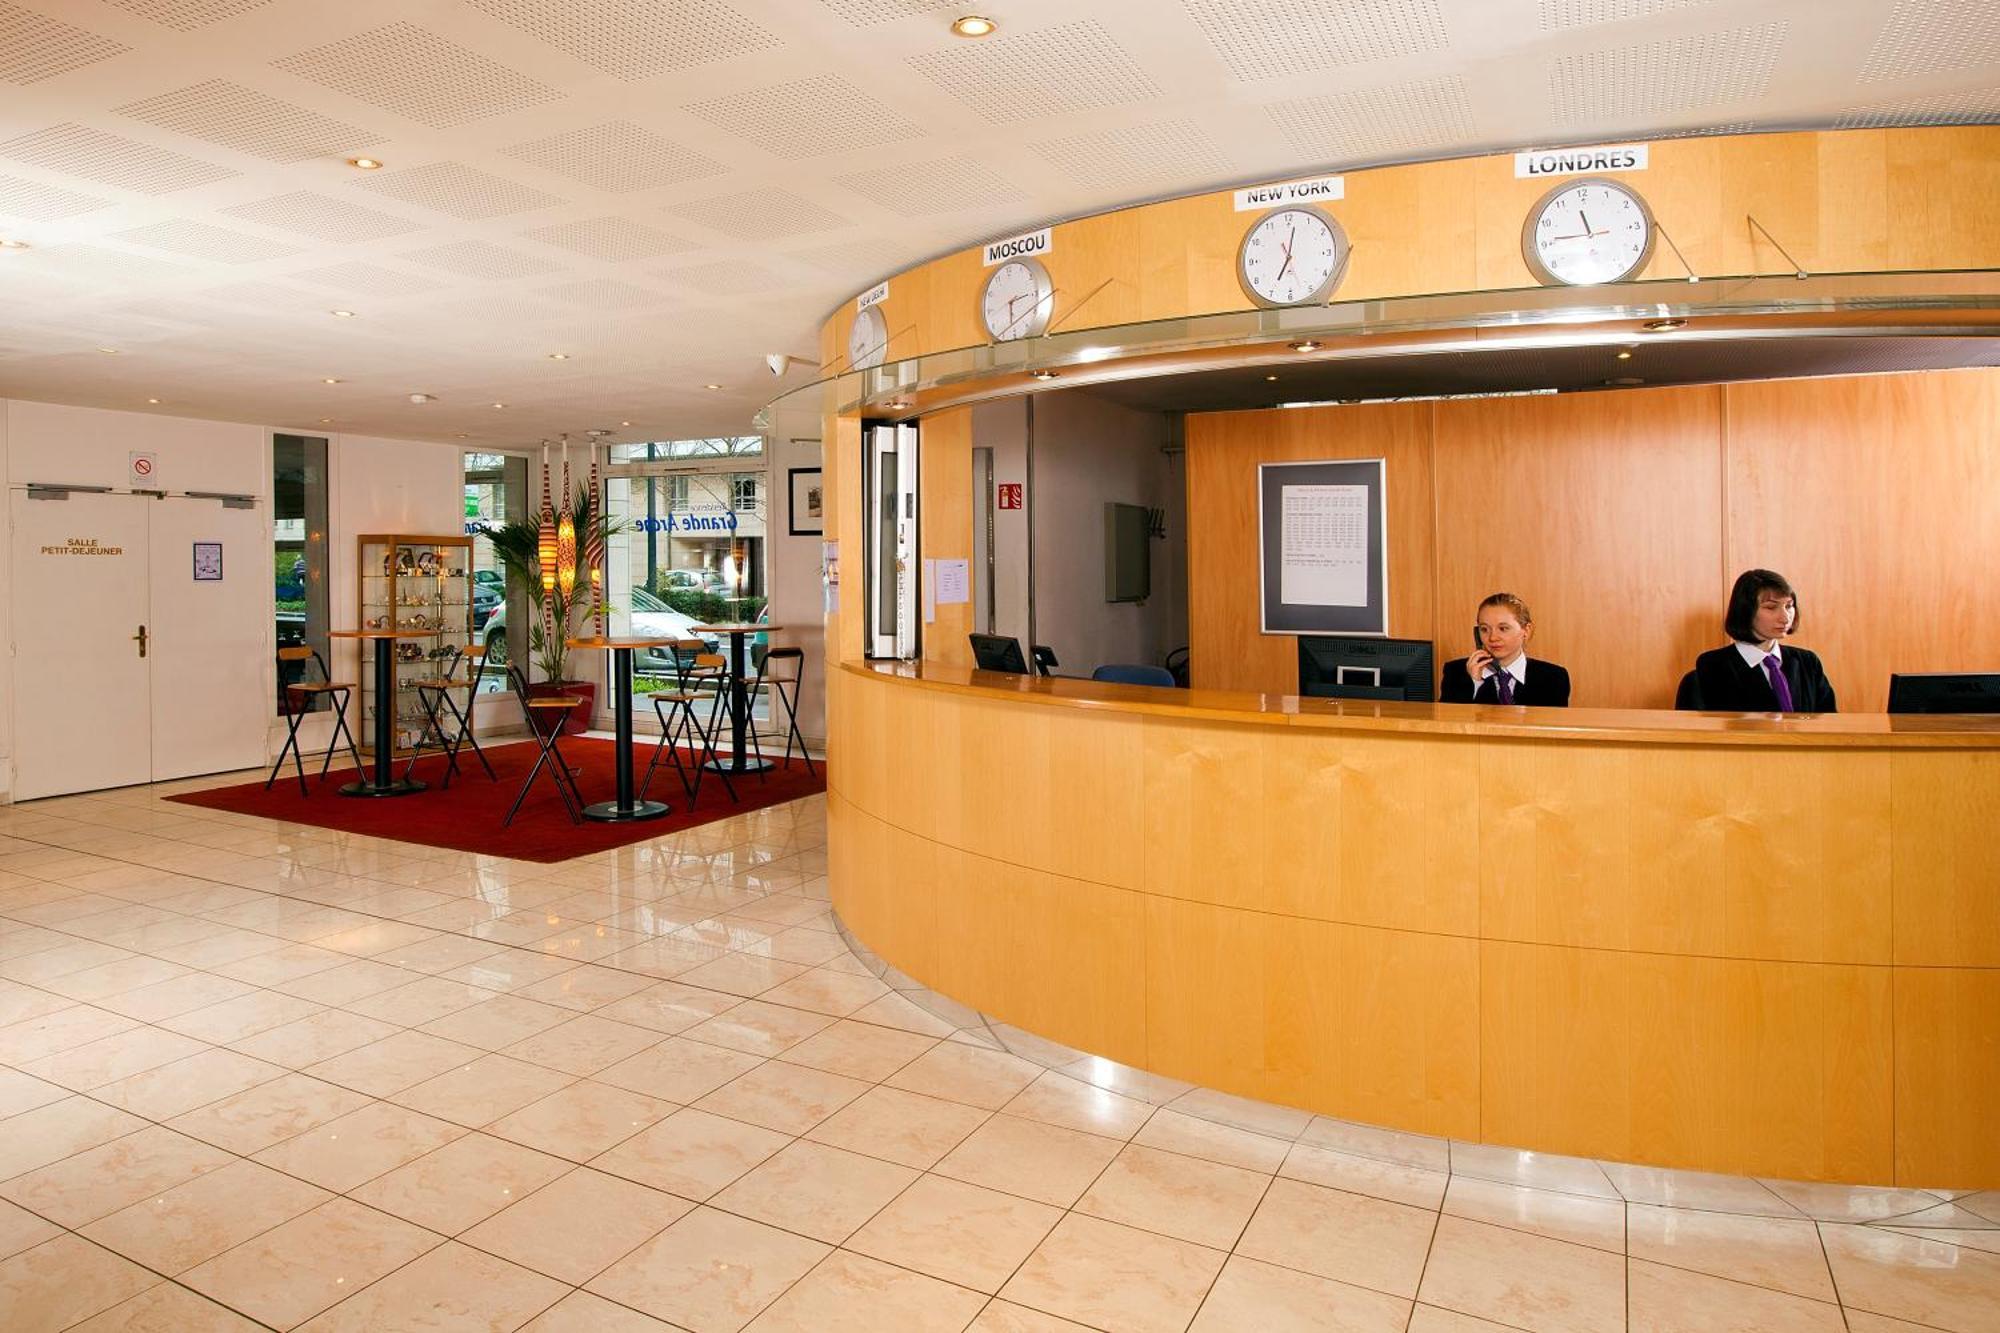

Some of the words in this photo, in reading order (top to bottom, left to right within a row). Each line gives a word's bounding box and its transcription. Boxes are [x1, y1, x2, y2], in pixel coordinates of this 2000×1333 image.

[1528, 150, 1636, 174] LONDRES
[1247, 188, 1283, 204] NEW
[1288, 181, 1331, 198] YORK
[1577, 189, 1588, 197] 12
[1556, 200, 1566, 208] 11
[1284, 214, 1293, 222] 12
[1541, 218, 1552, 227] 10
[989, 234, 1045, 261] MOSCOU
[67, 538, 98, 547] SALLE
